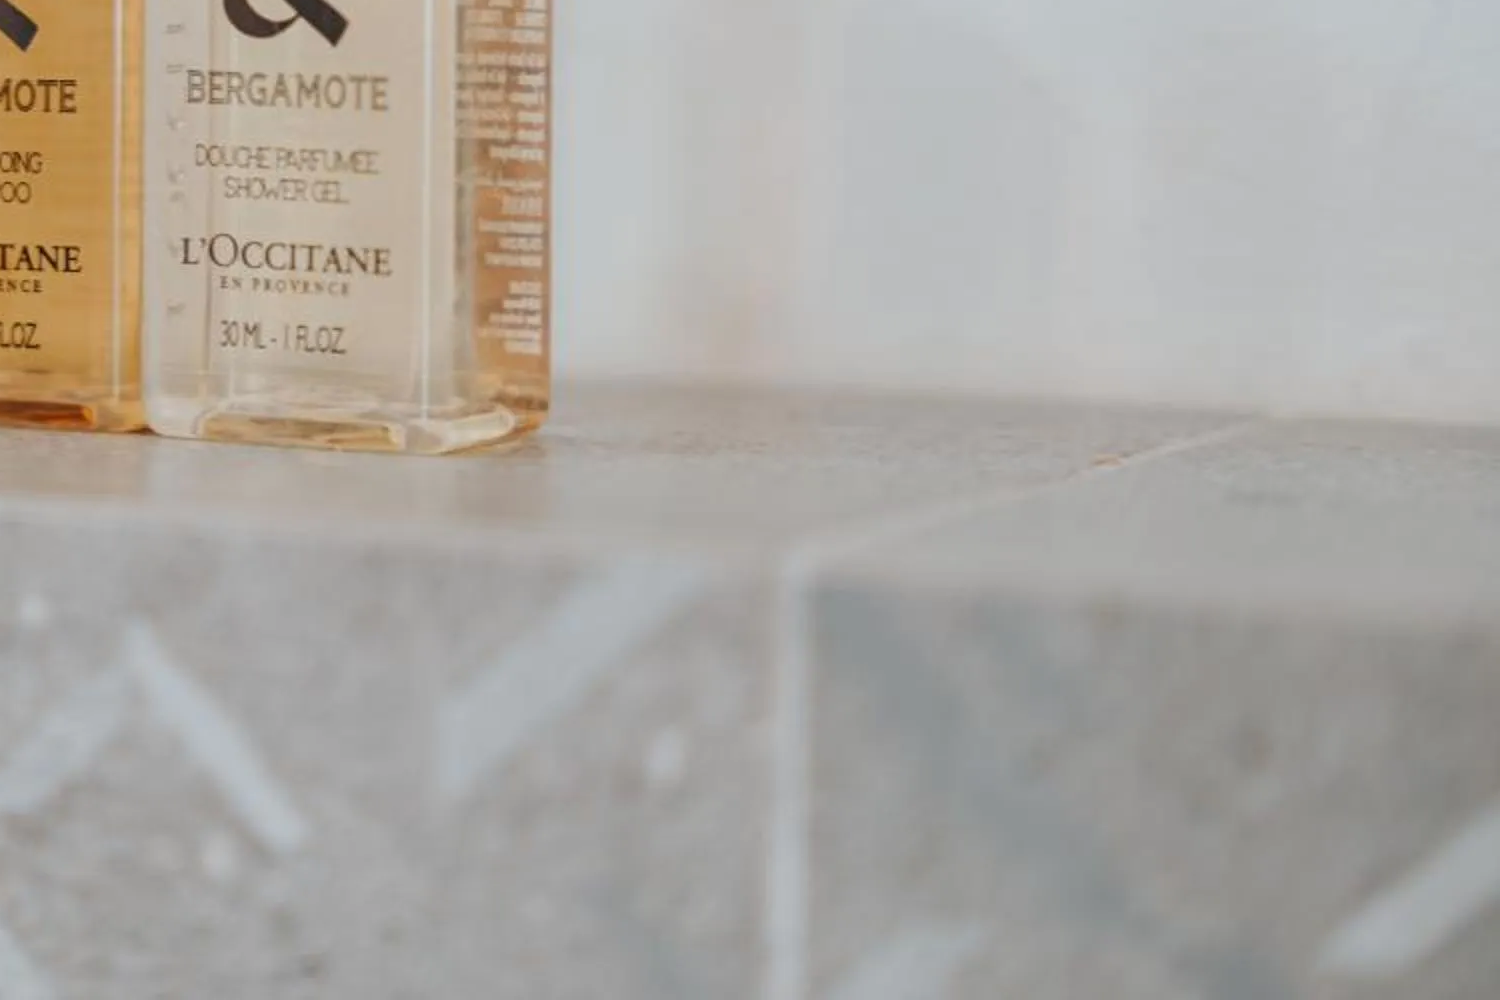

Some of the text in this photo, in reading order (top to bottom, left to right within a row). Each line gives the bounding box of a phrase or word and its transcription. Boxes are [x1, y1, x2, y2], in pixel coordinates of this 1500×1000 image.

[186, 70, 390, 112] BERGAMOTE
[224, 176, 349, 204] SHOWER GEL
[219, 275, 349, 296] EN PROVENCE
